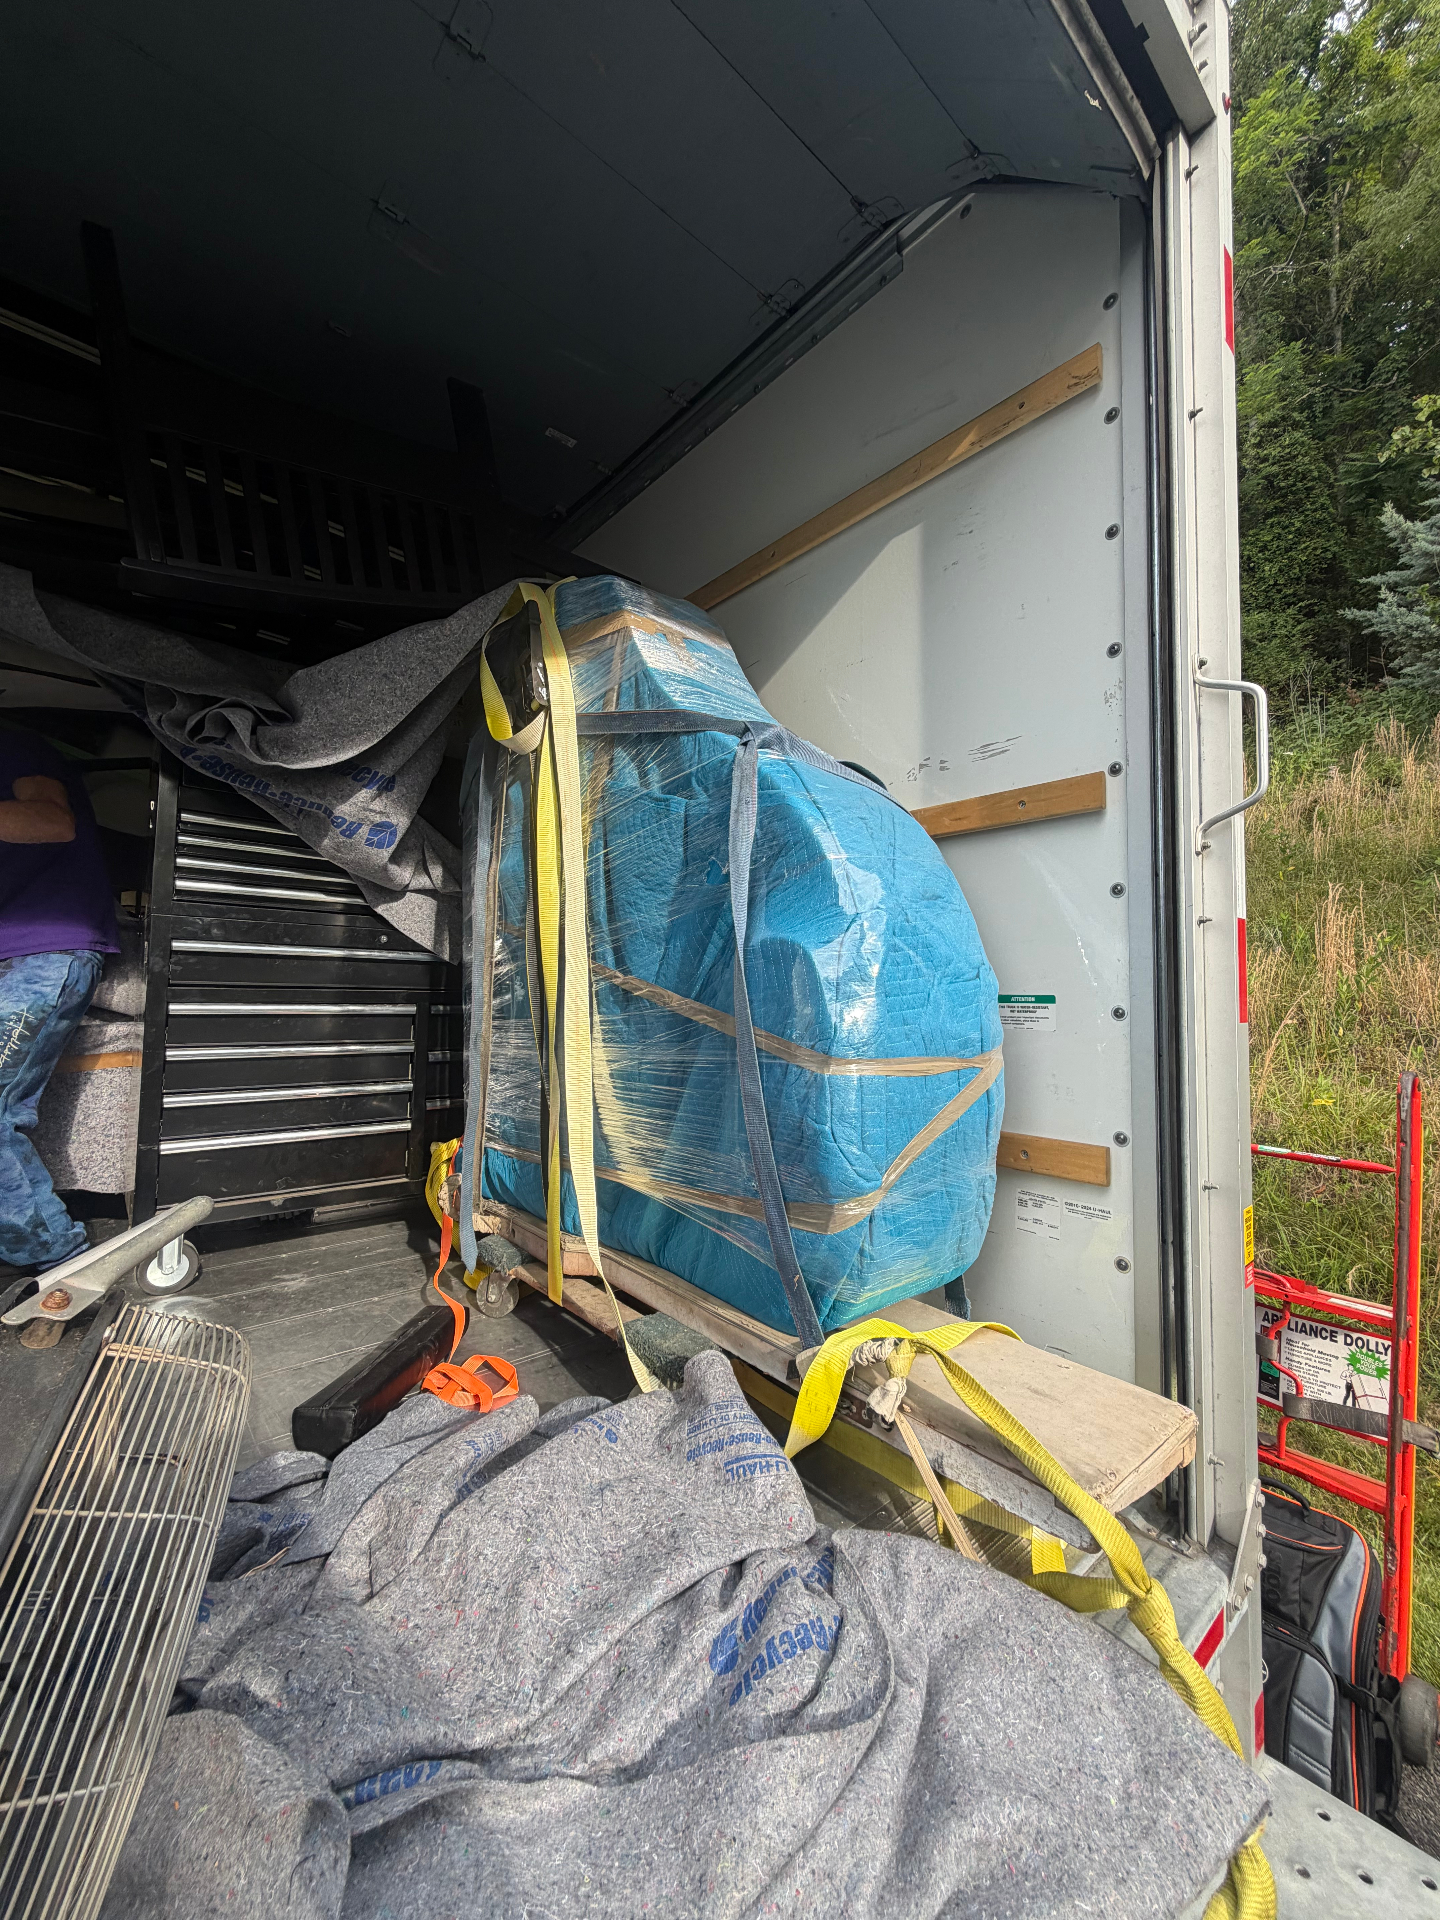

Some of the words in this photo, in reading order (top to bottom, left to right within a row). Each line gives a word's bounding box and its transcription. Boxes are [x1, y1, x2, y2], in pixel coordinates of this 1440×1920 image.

[1262, 1310, 1339, 1344] APLIANCE
[1343, 1333, 1392, 1357] DOLLY
[1317, 1349, 1338, 1359] Moving
[1356, 1352, 1384, 1368] DOUBLES
[1304, 1362, 1330, 1372] Features
[1356, 1364, 1377, 1375] POWER
[1360, 1359, 1376, 1370] YOUR
[725, 1459, 790, 1482] U-HAUL
[728, 1615, 830, 1708] Recycle
